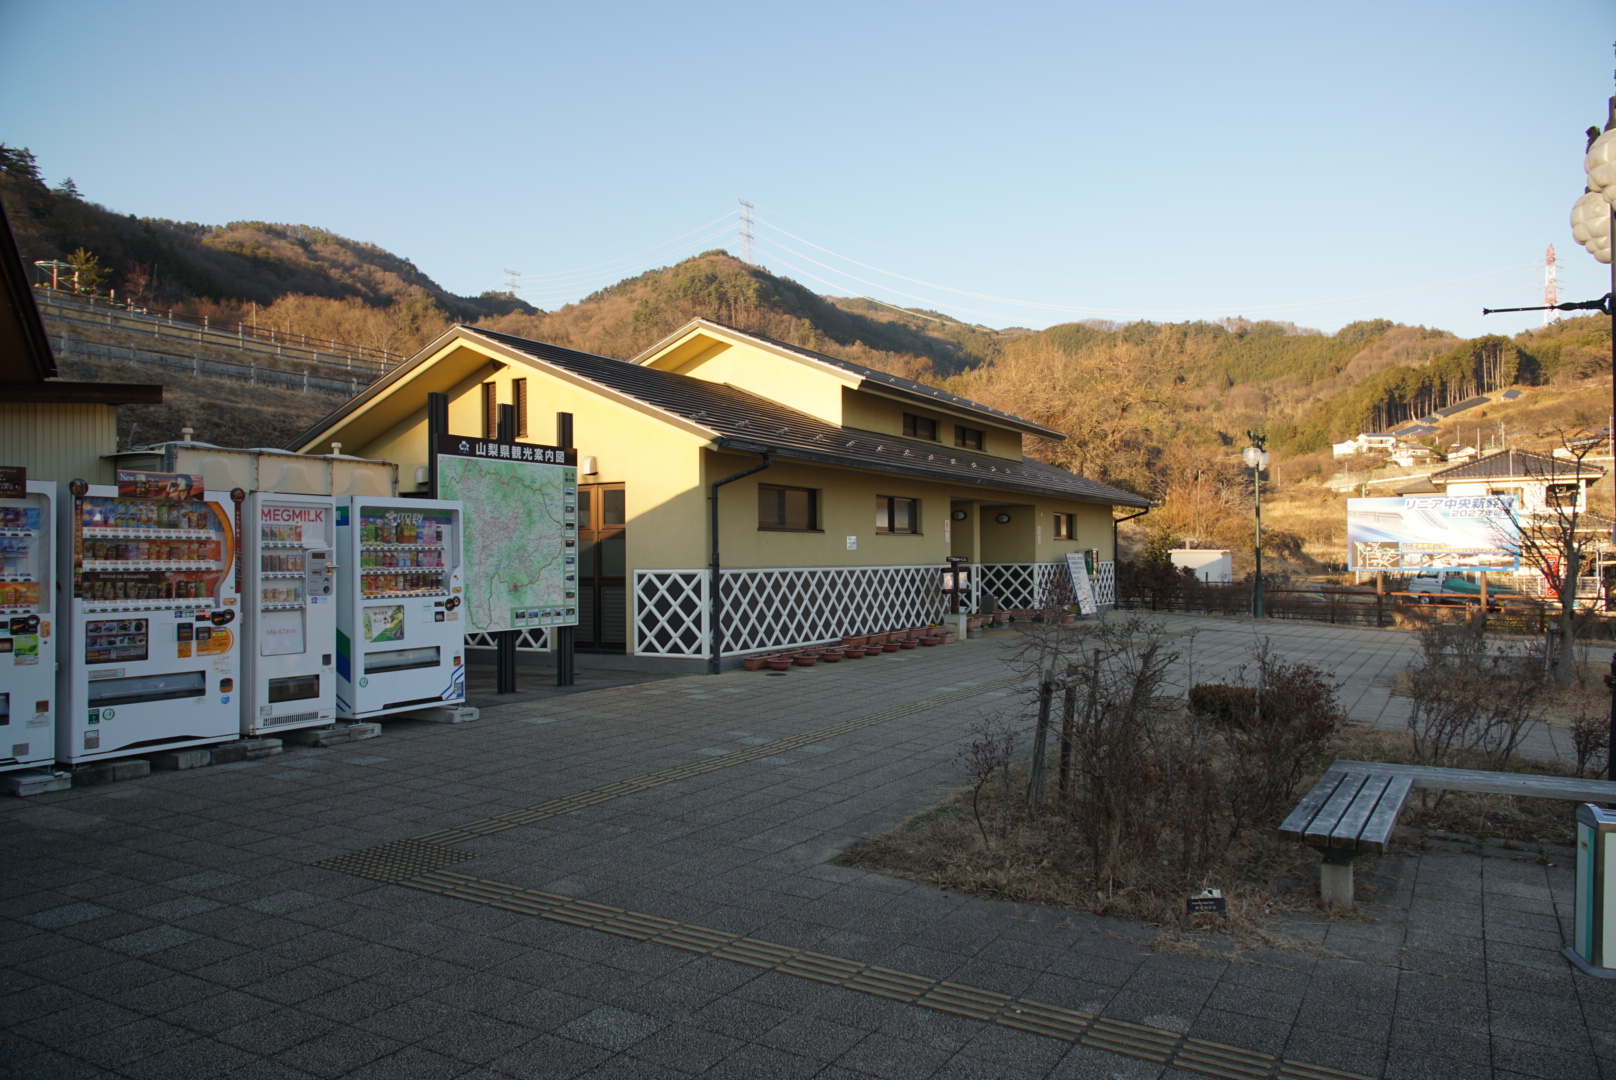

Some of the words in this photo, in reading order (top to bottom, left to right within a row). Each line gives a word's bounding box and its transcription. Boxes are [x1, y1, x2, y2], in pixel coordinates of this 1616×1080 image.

[475, 441, 565, 464] 山梨県観光案内図
[119, 473, 135, 481] New
[1406, 497, 1515, 510] リニア中央新幹線
[261, 508, 323, 524] MEGMILK
[397, 512, 412, 522] ITO
[413, 513, 424, 522] EN
[266, 628, 278, 636] Milk
[283, 627, 296, 635] Drink
